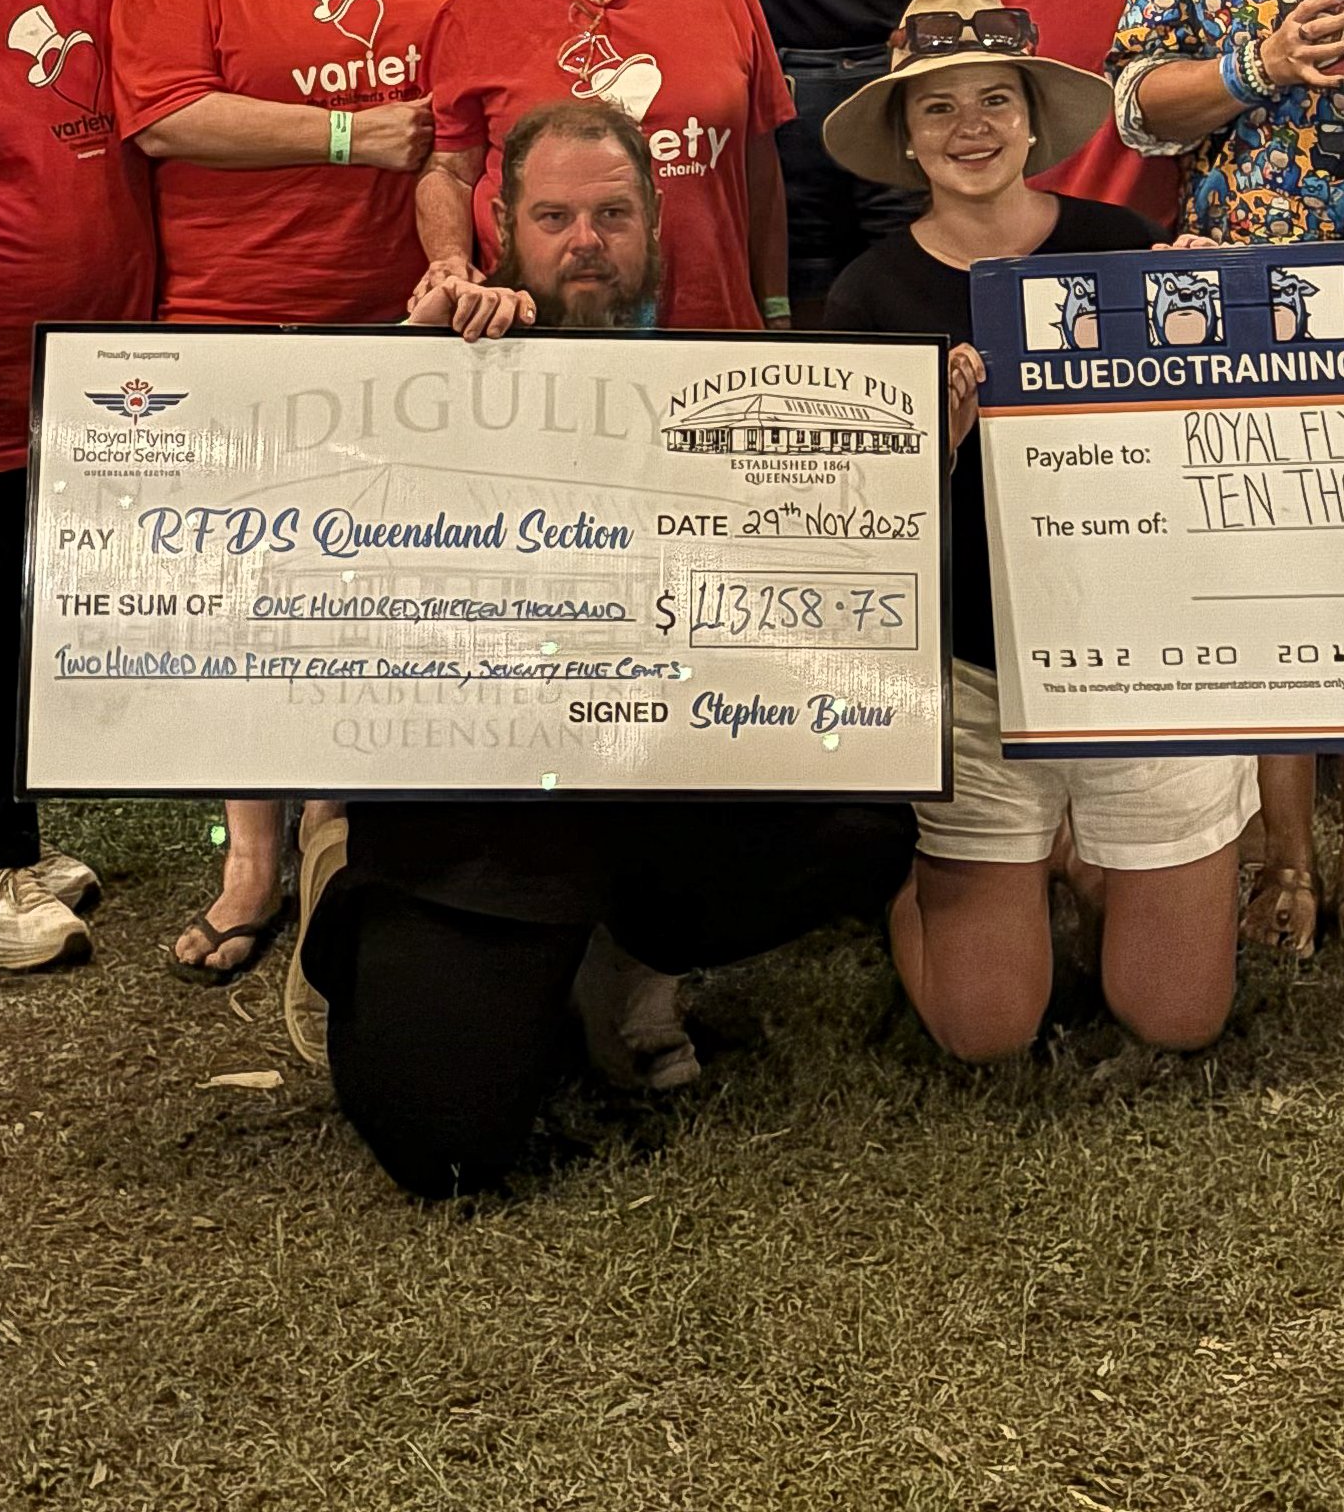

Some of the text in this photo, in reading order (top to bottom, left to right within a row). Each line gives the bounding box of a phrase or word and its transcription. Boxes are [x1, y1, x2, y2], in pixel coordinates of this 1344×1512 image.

[292, 43, 422, 96] variet
[51, 111, 116, 139] variety
[659, 161, 707, 177] charity
[97, 350, 180, 362] Proudly supporting
[668, 363, 915, 418] NINDIGULLY PUB
[86, 428, 186, 448] Royal Flying
[1183, 410, 1291, 465] ROYAL
[73, 446, 196, 464] Doctor Service
[731, 458, 851, 472] ESTABLISHED 1864
[1026, 443, 1152, 473] Payable to:
[745, 473, 836, 485] QUEENSLAND
[1182, 471, 1276, 530] TEN
[137, 506, 635, 559] RFDS Queensland Section
[657, 515, 729, 537] DATE
[742, 501, 928, 539] 29th NOV 2025
[1031, 512, 1169, 537] The sum of:
[59, 529, 115, 550] PAY
[56, 594, 225, 616] THE SUM OF
[253, 594, 306, 618] ONE
[512, 599, 626, 620] THOUSAND
[656, 589, 677, 636] $
[245, 651, 302, 684] FIFTY
[307, 657, 369, 678] EIGHT
[1043, 682, 1066, 693] This
[1089, 681, 1131, 694] novelty
[1132, 681, 1174, 694] cheque
[1176, 680, 1193, 691] for
[1194, 679, 1267, 692] presentation
[1269, 678, 1321, 691] purposes
[568, 701, 669, 724] SIGNED
[689, 691, 897, 738] Stephen Burns
